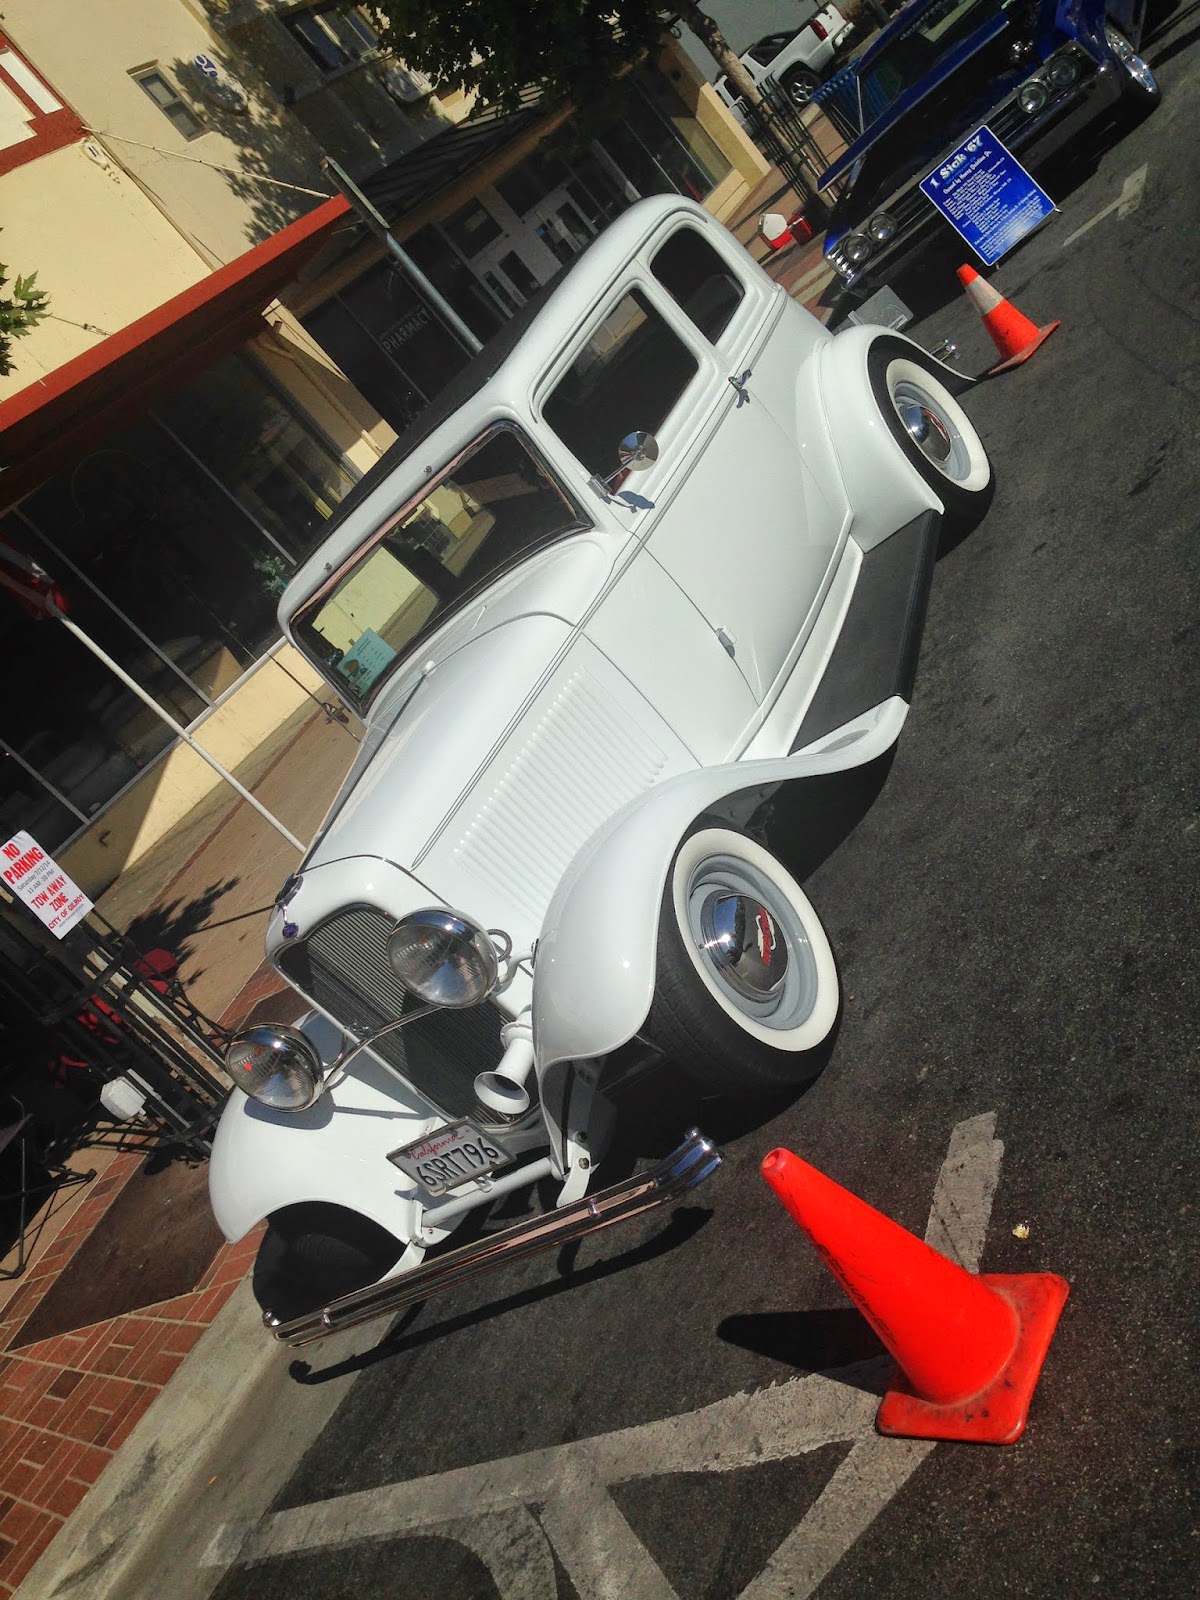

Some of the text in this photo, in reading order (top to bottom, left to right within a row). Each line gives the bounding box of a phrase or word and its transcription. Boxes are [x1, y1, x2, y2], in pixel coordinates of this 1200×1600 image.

[930, 178, 939, 188] 1
[940, 154, 967, 179] Sick
[964, 135, 983, 152] '67
[943, 180, 957, 194] Owned
[383, 307, 432, 354] PHARMACY
[2, 843, 21, 861] NO
[3, 847, 45, 885] PARKING
[17, 861, 51, 892] Saturday 7/12/14
[31, 875, 67, 909] TOW AWAY
[33, 879, 42, 890] AM
[47, 869, 55, 879] PM
[48, 916, 62, 929] CITY
[60, 909, 68, 918] OF
[68, 893, 85, 911] GILROY
[49, 893, 69, 911] ZONE
[410, 1131, 464, 1160] California
[416, 1137, 499, 1186] 6SRT796
